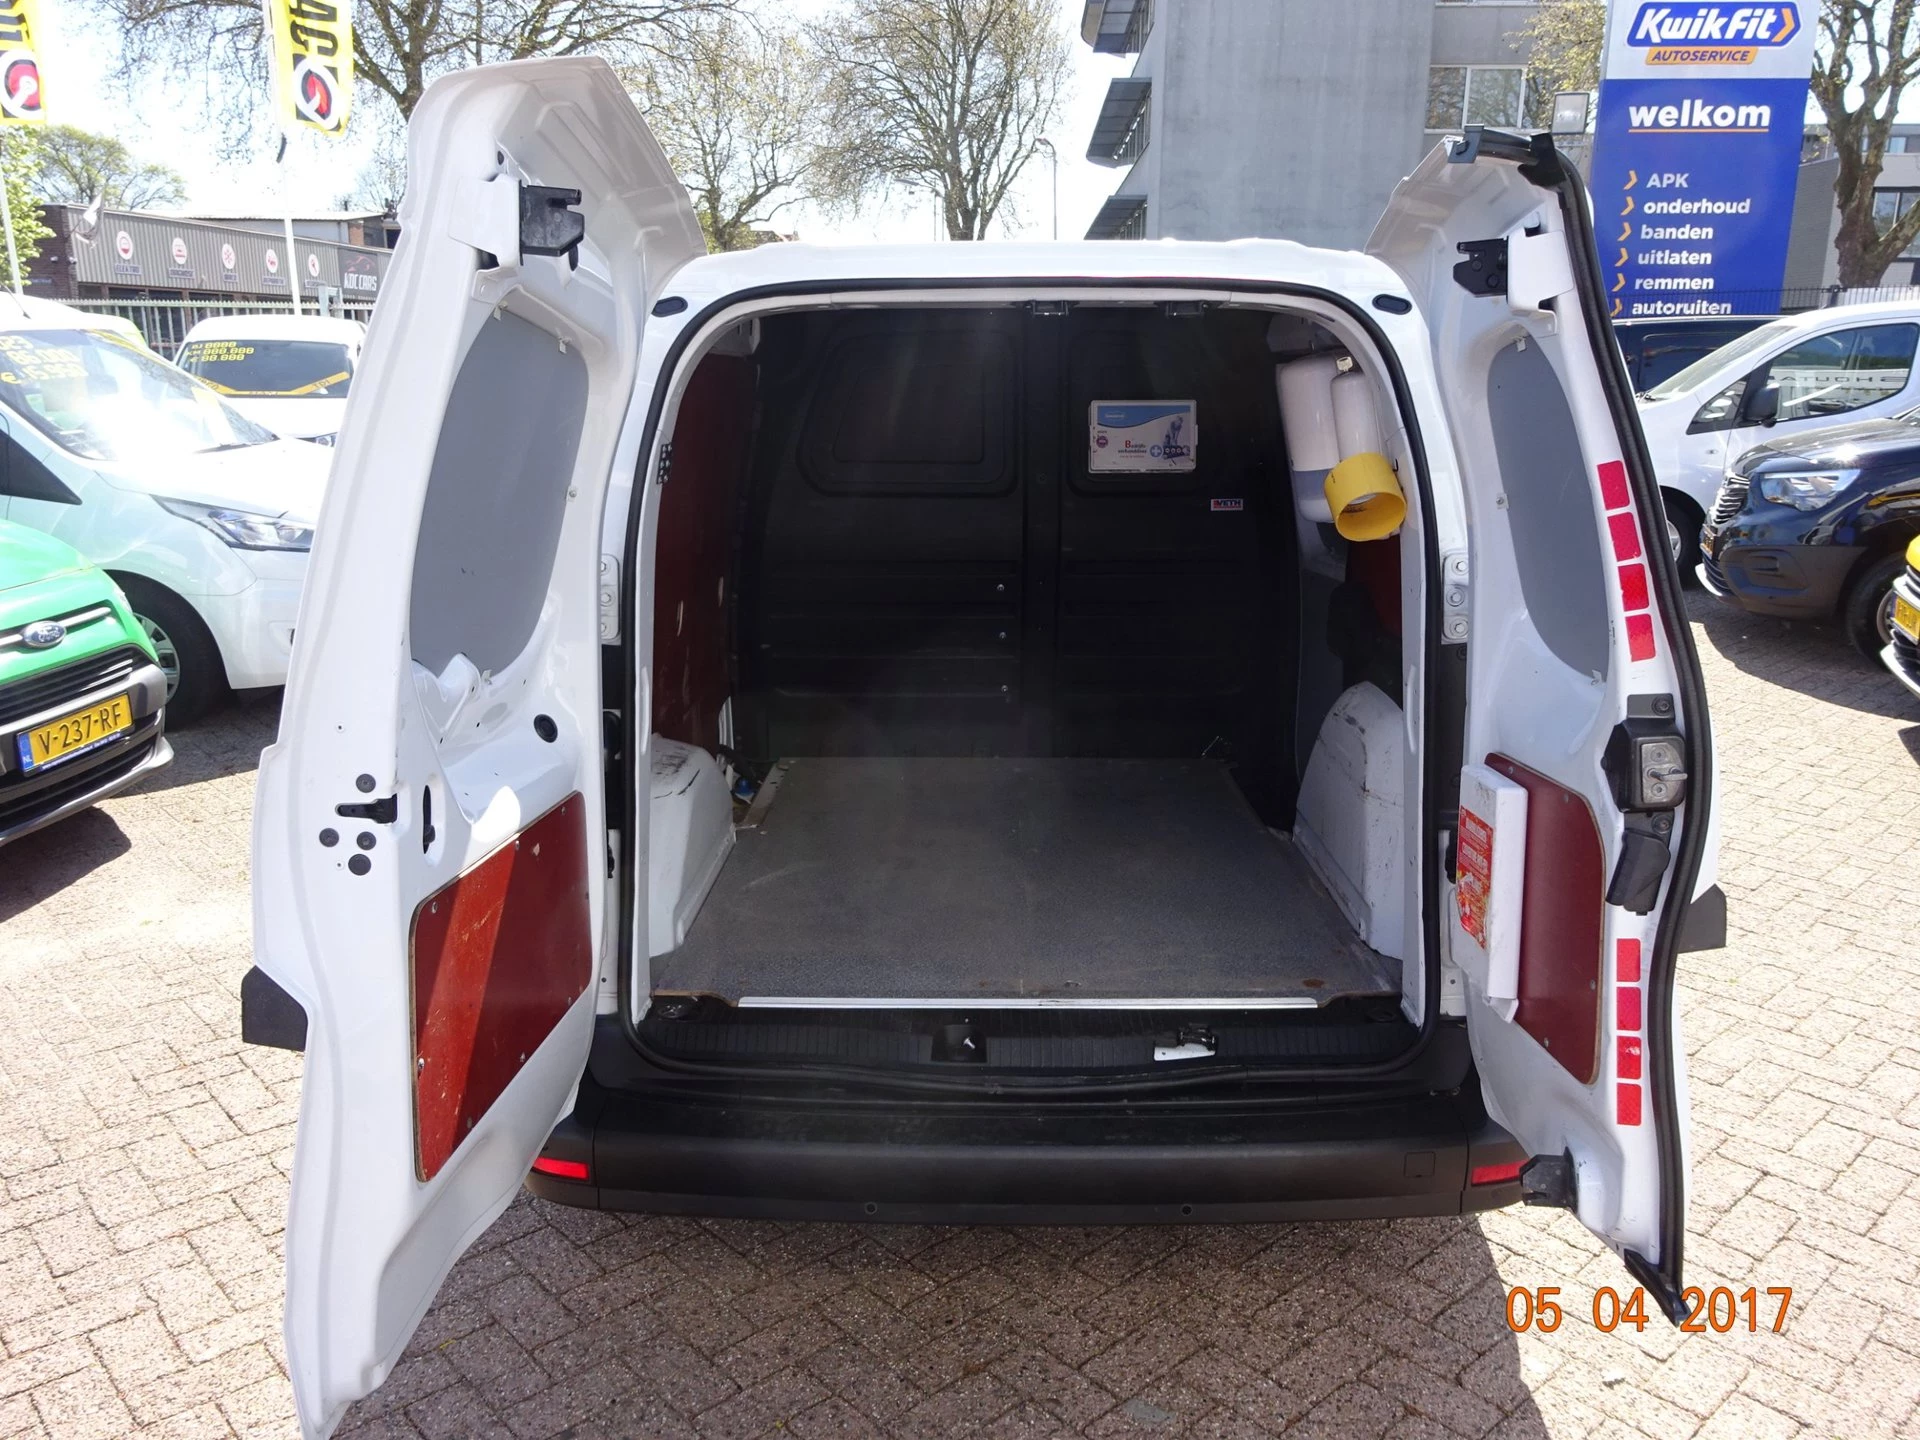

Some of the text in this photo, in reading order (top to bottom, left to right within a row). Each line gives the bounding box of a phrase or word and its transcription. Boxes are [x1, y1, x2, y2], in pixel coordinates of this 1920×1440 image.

[1635, 8, 1777, 42] KwikFit
[1651, 50, 1750, 62] AUTOSERVICE
[1628, 99, 1771, 127] welkom
[1646, 173, 1689, 188] APK
[1643, 198, 1751, 215] onderhoud
[1640, 224, 1714, 240] banden
[1637, 249, 1712, 265] uitlaten
[1635, 277, 1714, 290] remmen
[1632, 301, 1732, 315] autoruiten
[39, 702, 121, 755] V-237-RF
[23, 755, 33, 763] NL
